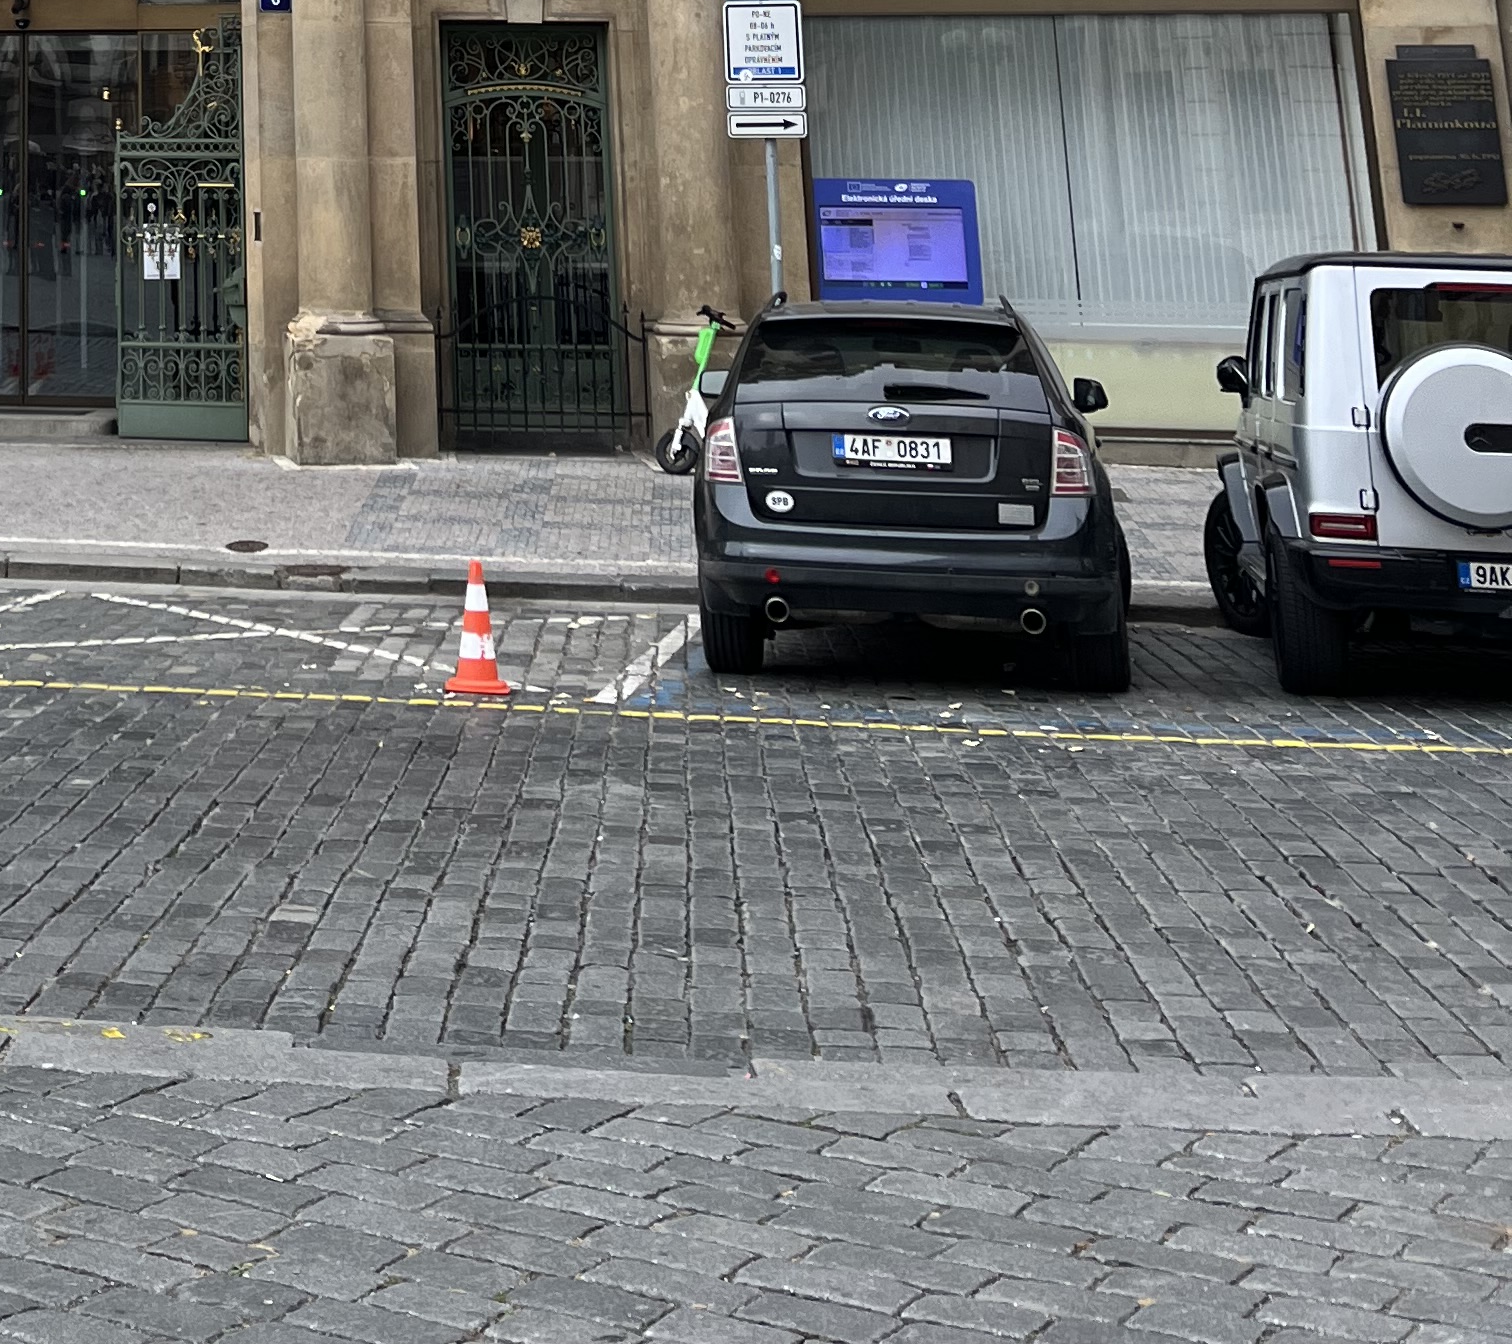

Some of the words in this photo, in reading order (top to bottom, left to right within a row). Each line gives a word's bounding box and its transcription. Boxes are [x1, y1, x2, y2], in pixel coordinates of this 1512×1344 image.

[753, 92, 792, 104] P1-0276
[850, 438, 882, 457] 4AF
[897, 440, 941, 460] 0831
[771, 497, 789, 506] SPB
[1476, 566, 1512, 587] 9AK
